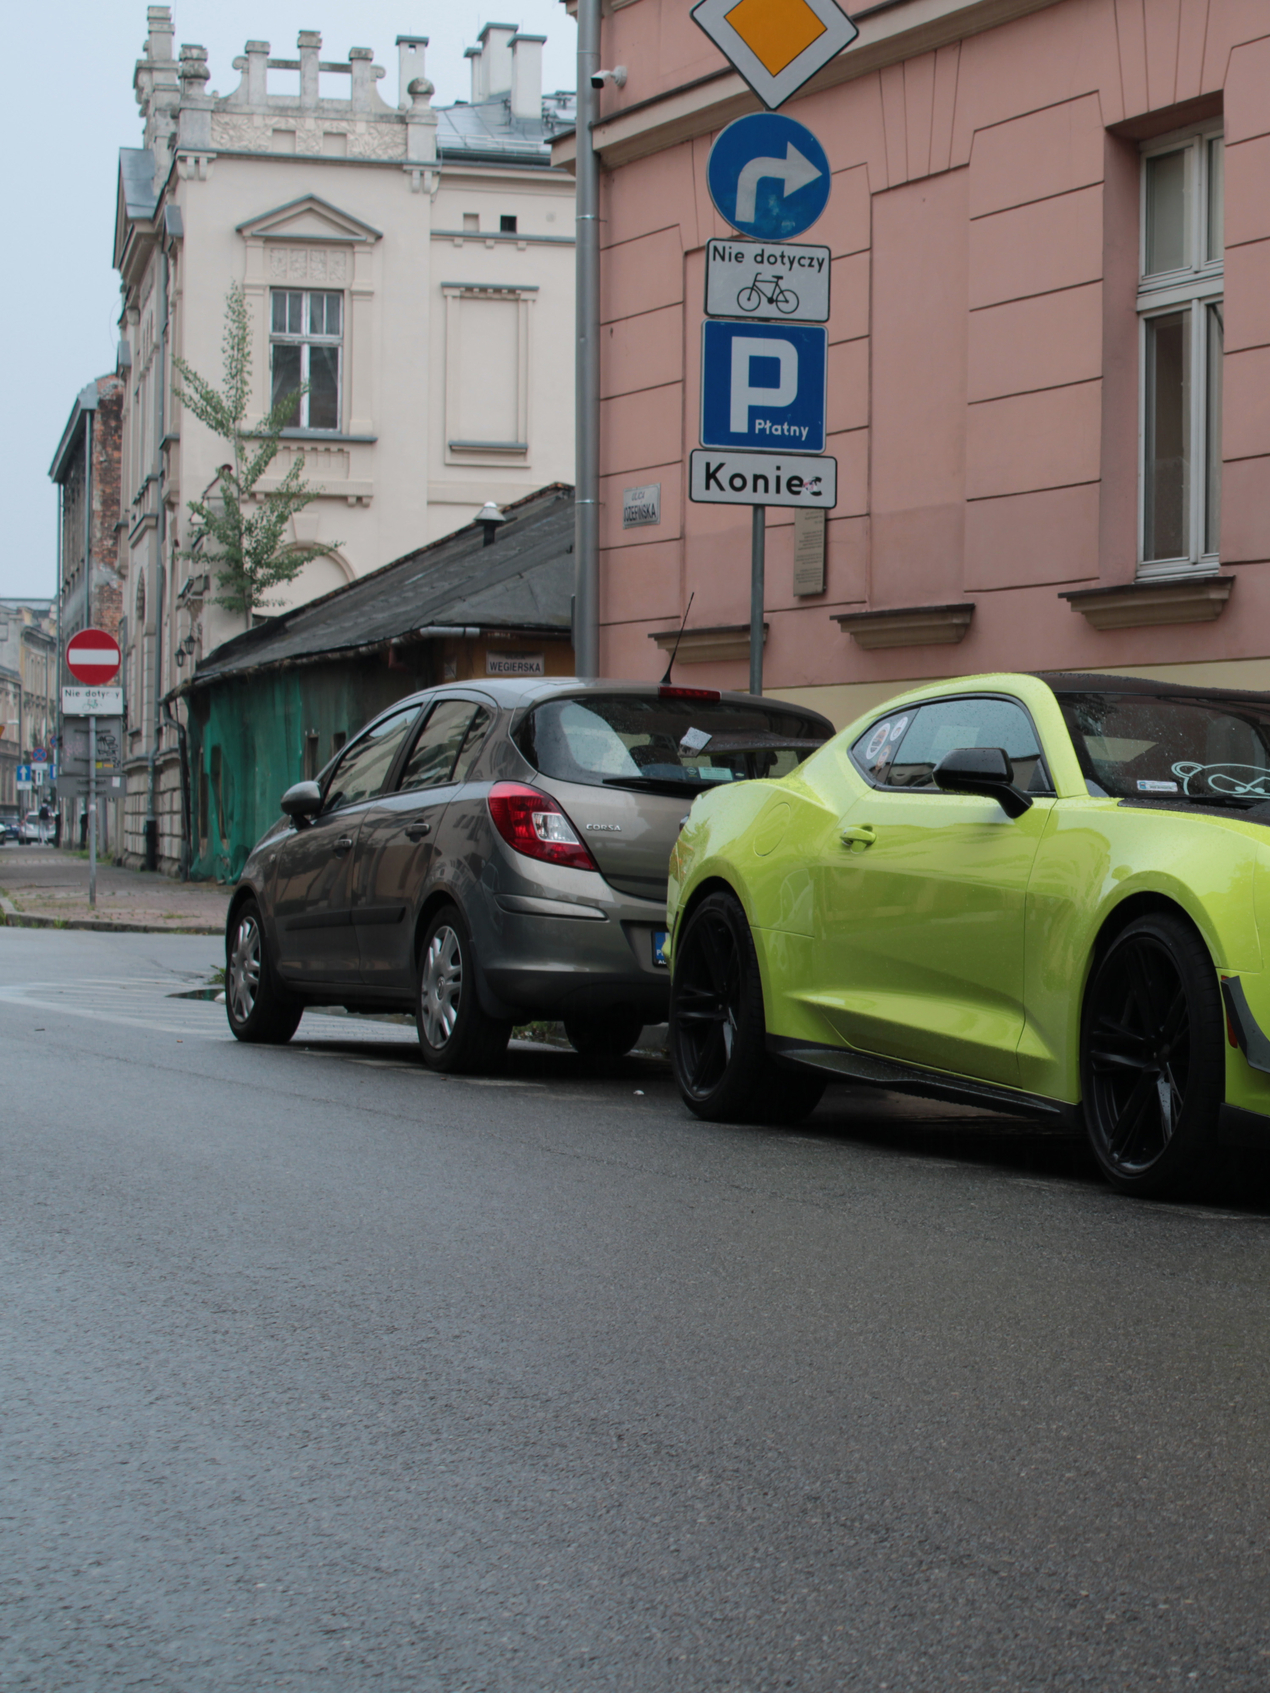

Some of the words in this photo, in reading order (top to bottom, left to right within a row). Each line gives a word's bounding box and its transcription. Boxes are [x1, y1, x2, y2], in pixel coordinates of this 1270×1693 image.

[712, 245, 745, 263] Nie
[754, 248, 826, 275] dotyczy
[731, 337, 798, 433] P
[755, 419, 809, 441] Płatny
[704, 462, 823, 497] Koniec
[489, 661, 541, 672] WĘGIERSKA
[65, 689, 80, 697] Nie
[85, 689, 120, 699] dotyy
